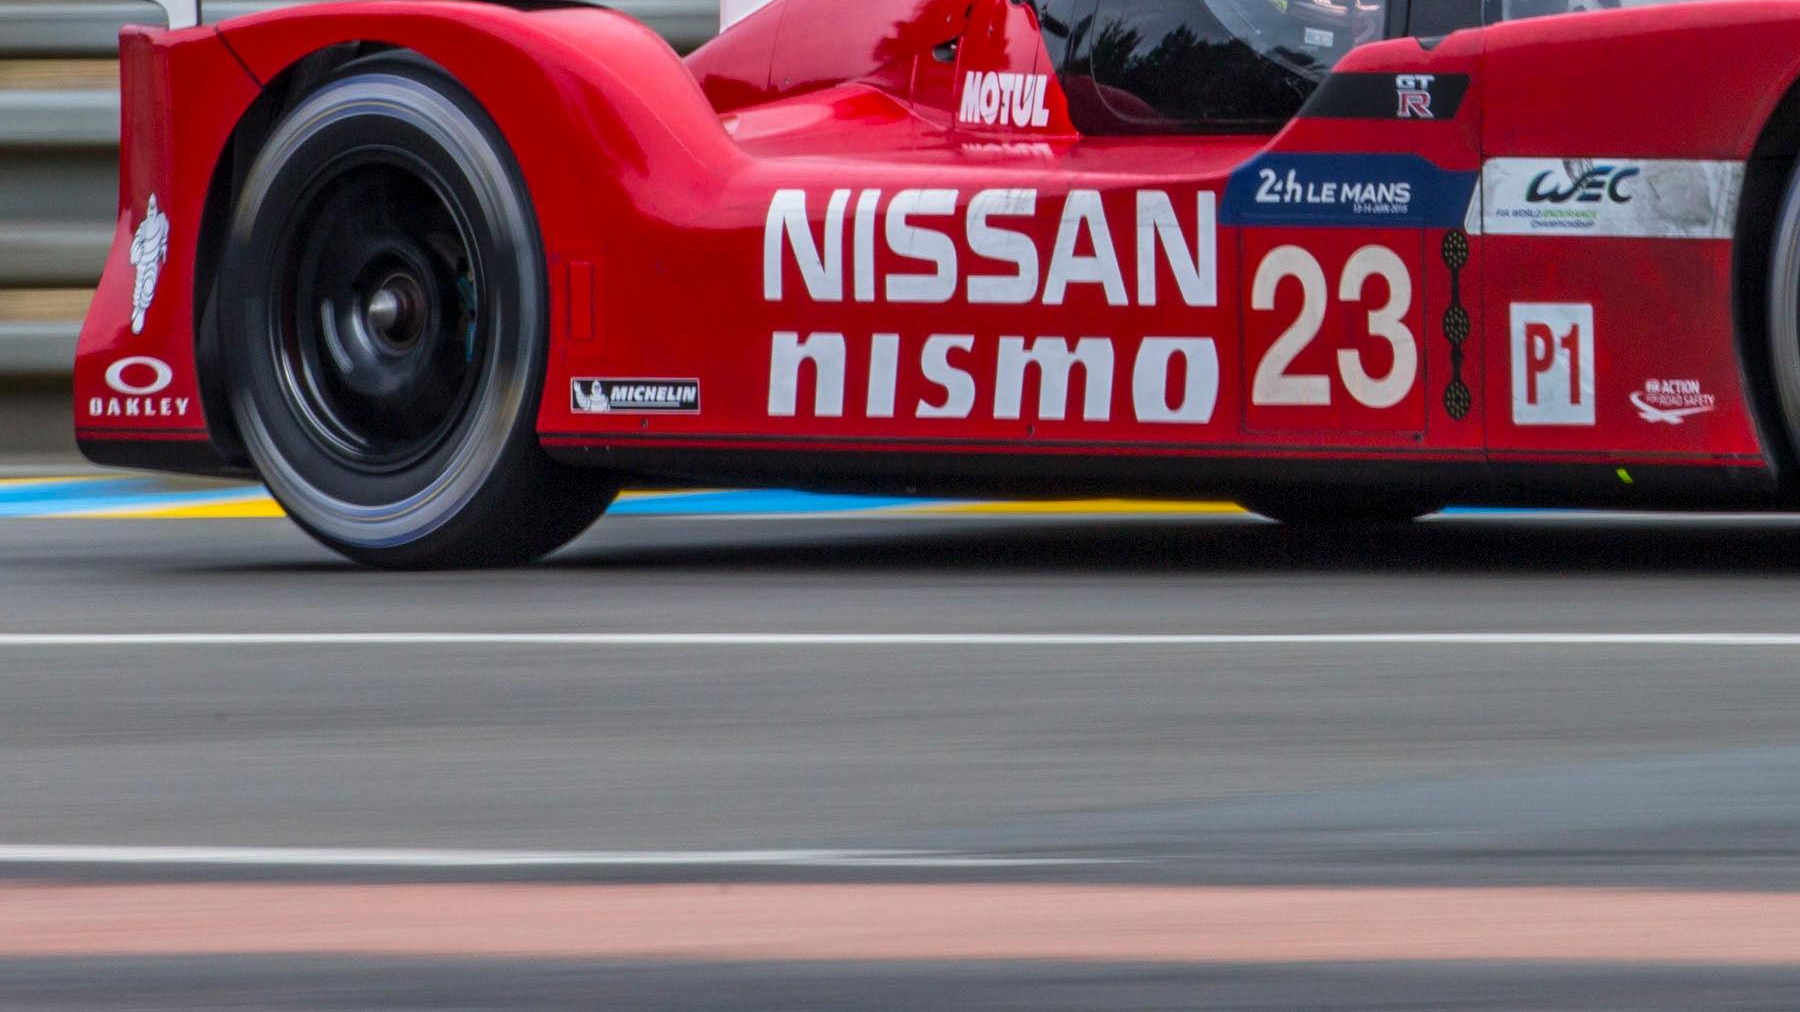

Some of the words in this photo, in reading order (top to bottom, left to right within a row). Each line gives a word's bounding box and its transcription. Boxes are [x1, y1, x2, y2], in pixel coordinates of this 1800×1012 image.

[960, 71, 1050, 127] MOTUL
[1307, 183, 1337, 203] LE
[1340, 183, 1411, 204] MANS
[1526, 166, 1640, 202] WEC
[764, 189, 1218, 307] NISSAN
[1252, 244, 1418, 408] 23
[767, 331, 1219, 424] nismo
[1526, 322, 1581, 406] P1
[1662, 379, 1699, 394] ACTION
[89, 396, 189, 416] OAKLEY
[610, 386, 696, 402] MICHELIN
